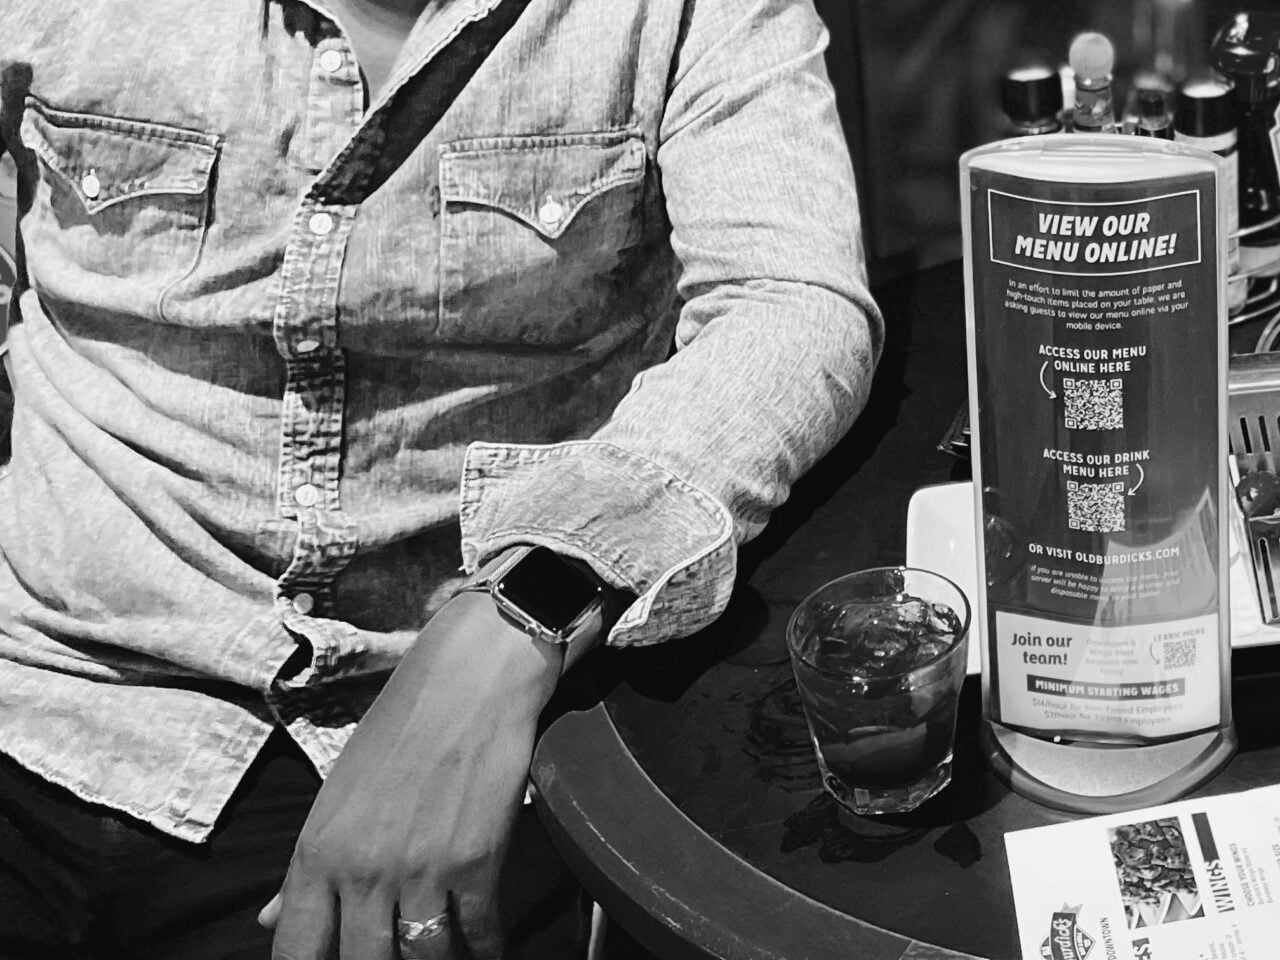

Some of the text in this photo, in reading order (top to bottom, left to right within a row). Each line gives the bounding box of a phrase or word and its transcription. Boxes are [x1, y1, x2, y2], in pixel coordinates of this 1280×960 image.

[1038, 212, 1150, 237] VIEW OUR
[1014, 233, 1178, 263] MENU ONLINE!
[1017, 282, 1027, 290] an
[1029, 282, 1050, 295] effort
[1052, 287, 1060, 296] to
[1062, 288, 1079, 297] limit
[1082, 289, 1096, 298] the
[1098, 289, 1130, 298] amount
[1132, 285, 1140, 295] of
[1142, 283, 1165, 295] paper
[1167, 279, 1182, 290] and
[1006, 289, 1046, 305] high-touch
[1047, 297, 1070, 308] items
[1071, 300, 1099, 310] placed
[1100, 301, 1111, 309] on
[1112, 299, 1132, 310] your
[1157, 293, 1170, 302] we
[1172, 291, 1186, 300] are
[1004, 300, 1190, 320] asking guests to view our menu online via your
[1066, 321, 1093, 331] mobile
[1038, 344, 1147, 360] ACCESS OUR MENU
[1054, 360, 1131, 374] ONLINE HERE
[1042, 448, 1150, 465] ACCESS OUR DRINK
[1063, 464, 1130, 478] MENU HERE
[1028, 543, 1180, 565] OR VISIT OLDBURDICKS.COM
[1011, 632, 1072, 648] Join our
[1153, 627, 1205, 642] LEARN MORE
[1022, 651, 1068, 665] team!
[1035, 679, 1180, 697] MINIMUM STARTING WAGES
[1229, 843, 1255, 906] CHOOSE YOUR WINGS
[1204, 858, 1235, 912] WINGS
[1053, 918, 1073, 960] urdick's
[1099, 917, 1117, 960] DOWNTOWN
